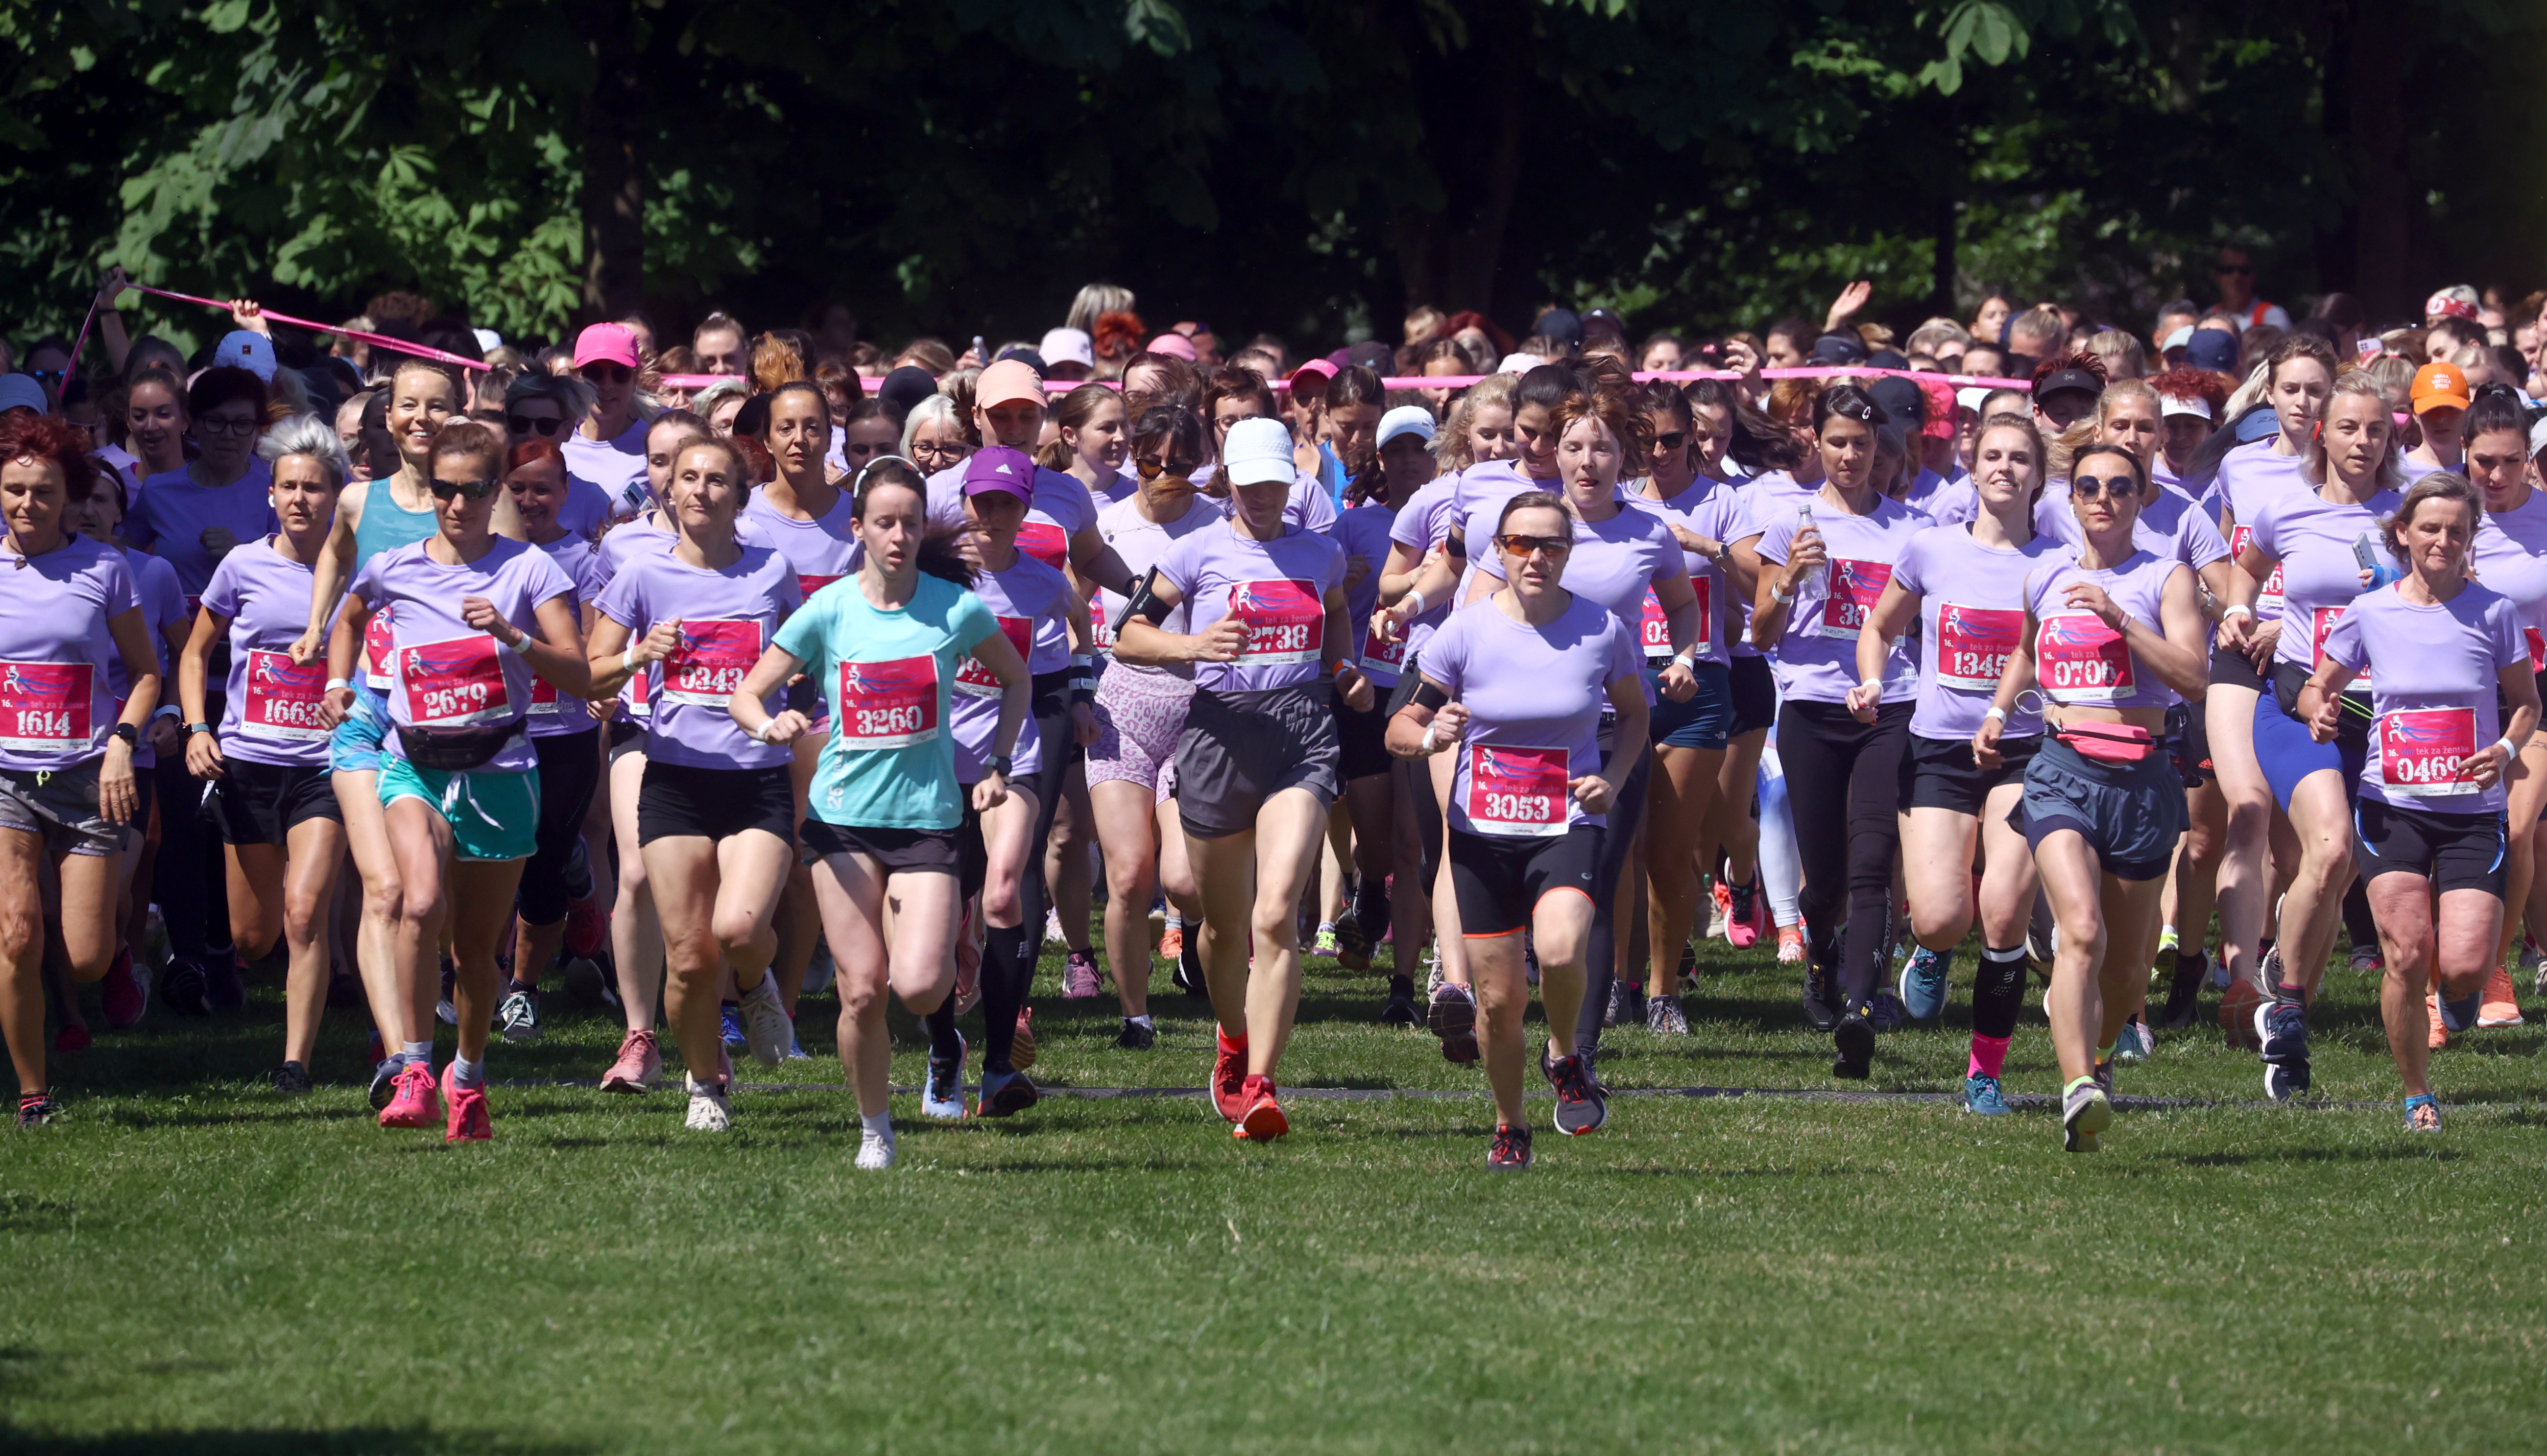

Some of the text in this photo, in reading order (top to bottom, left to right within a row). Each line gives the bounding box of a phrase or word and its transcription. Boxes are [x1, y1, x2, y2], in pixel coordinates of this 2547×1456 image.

[1861, 595, 1873, 603] tek
[1246, 624, 1308, 651] 2738
[1944, 639, 1954, 647] 16.
[1900, 667, 1916, 676] dm
[1954, 651, 2010, 677] 1345
[2054, 660, 2116, 686] 0706
[253, 687, 264, 695] 16.
[410, 683, 423, 692] 16.
[679, 667, 744, 692] 0343
[264, 698, 320, 726] 1663
[423, 683, 487, 717] 2679
[845, 699, 857, 708] 16.
[16, 710, 71, 737] 1614
[856, 705, 923, 734] 3260
[2443, 745, 2469, 754] ženske
[2397, 756, 2461, 782] 0469
[1478, 781, 1488, 790] 16.
[1485, 792, 1550, 820] 3053
